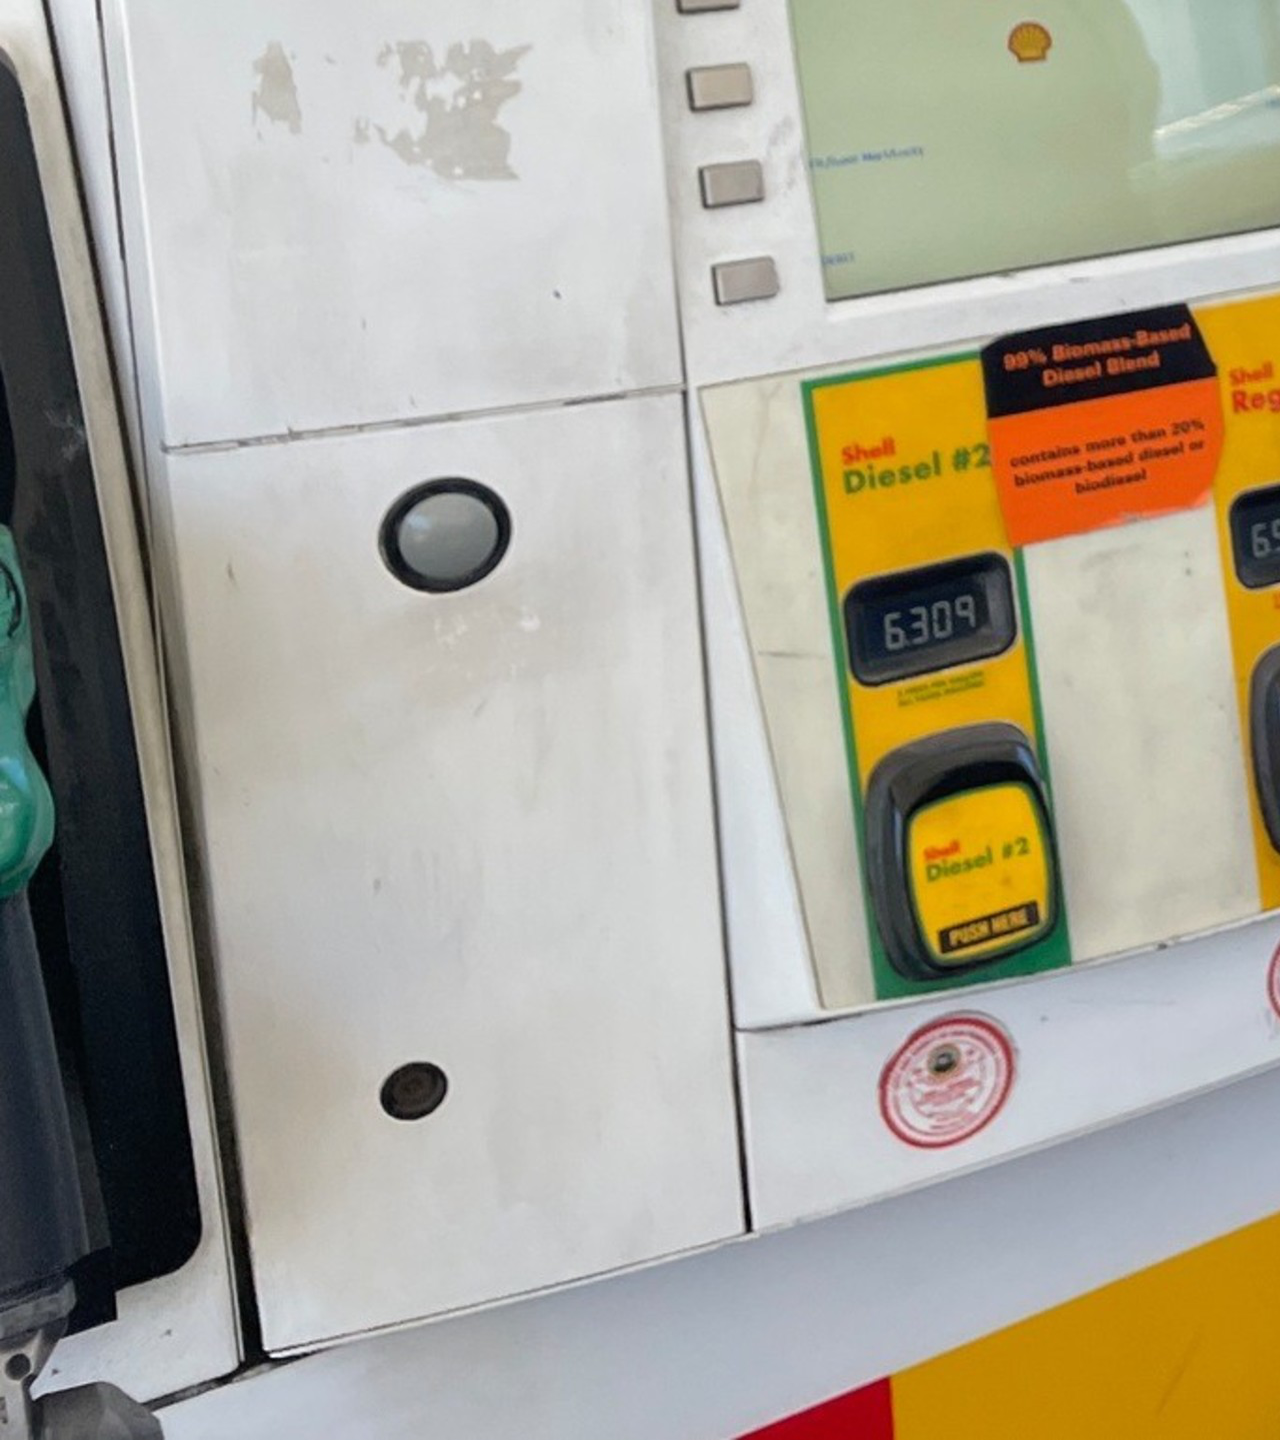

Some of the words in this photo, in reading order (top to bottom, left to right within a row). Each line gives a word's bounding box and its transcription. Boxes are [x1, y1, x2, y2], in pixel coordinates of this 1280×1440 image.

[1004, 347, 1046, 371] 99%
[1052, 323, 1191, 361] Biomass-Based
[1042, 361, 1102, 387] Diesel
[1106, 350, 1160, 375] Blend
[1229, 361, 1274, 386] Shell
[841, 437, 895, 466] Shell
[1010, 445, 1080, 468] contains
[1086, 436, 1126, 452] more
[1131, 427, 1166, 443] than
[1172, 418, 1204, 436] 20%
[844, 452, 941, 494] Diesel
[952, 443, 990, 472] #2
[1014, 455, 1134, 487] biomass-based
[1139, 442, 1184, 462] diesel
[1189, 440, 1204, 451] or
[1076, 469, 1147, 494] biodiesel
[923, 840, 960, 861] Shell
[925, 847, 993, 882] Diesel
[1002, 836, 1030, 858] #2
[949, 920, 988, 947] PUSH
[992, 908, 1027, 935] HERE
